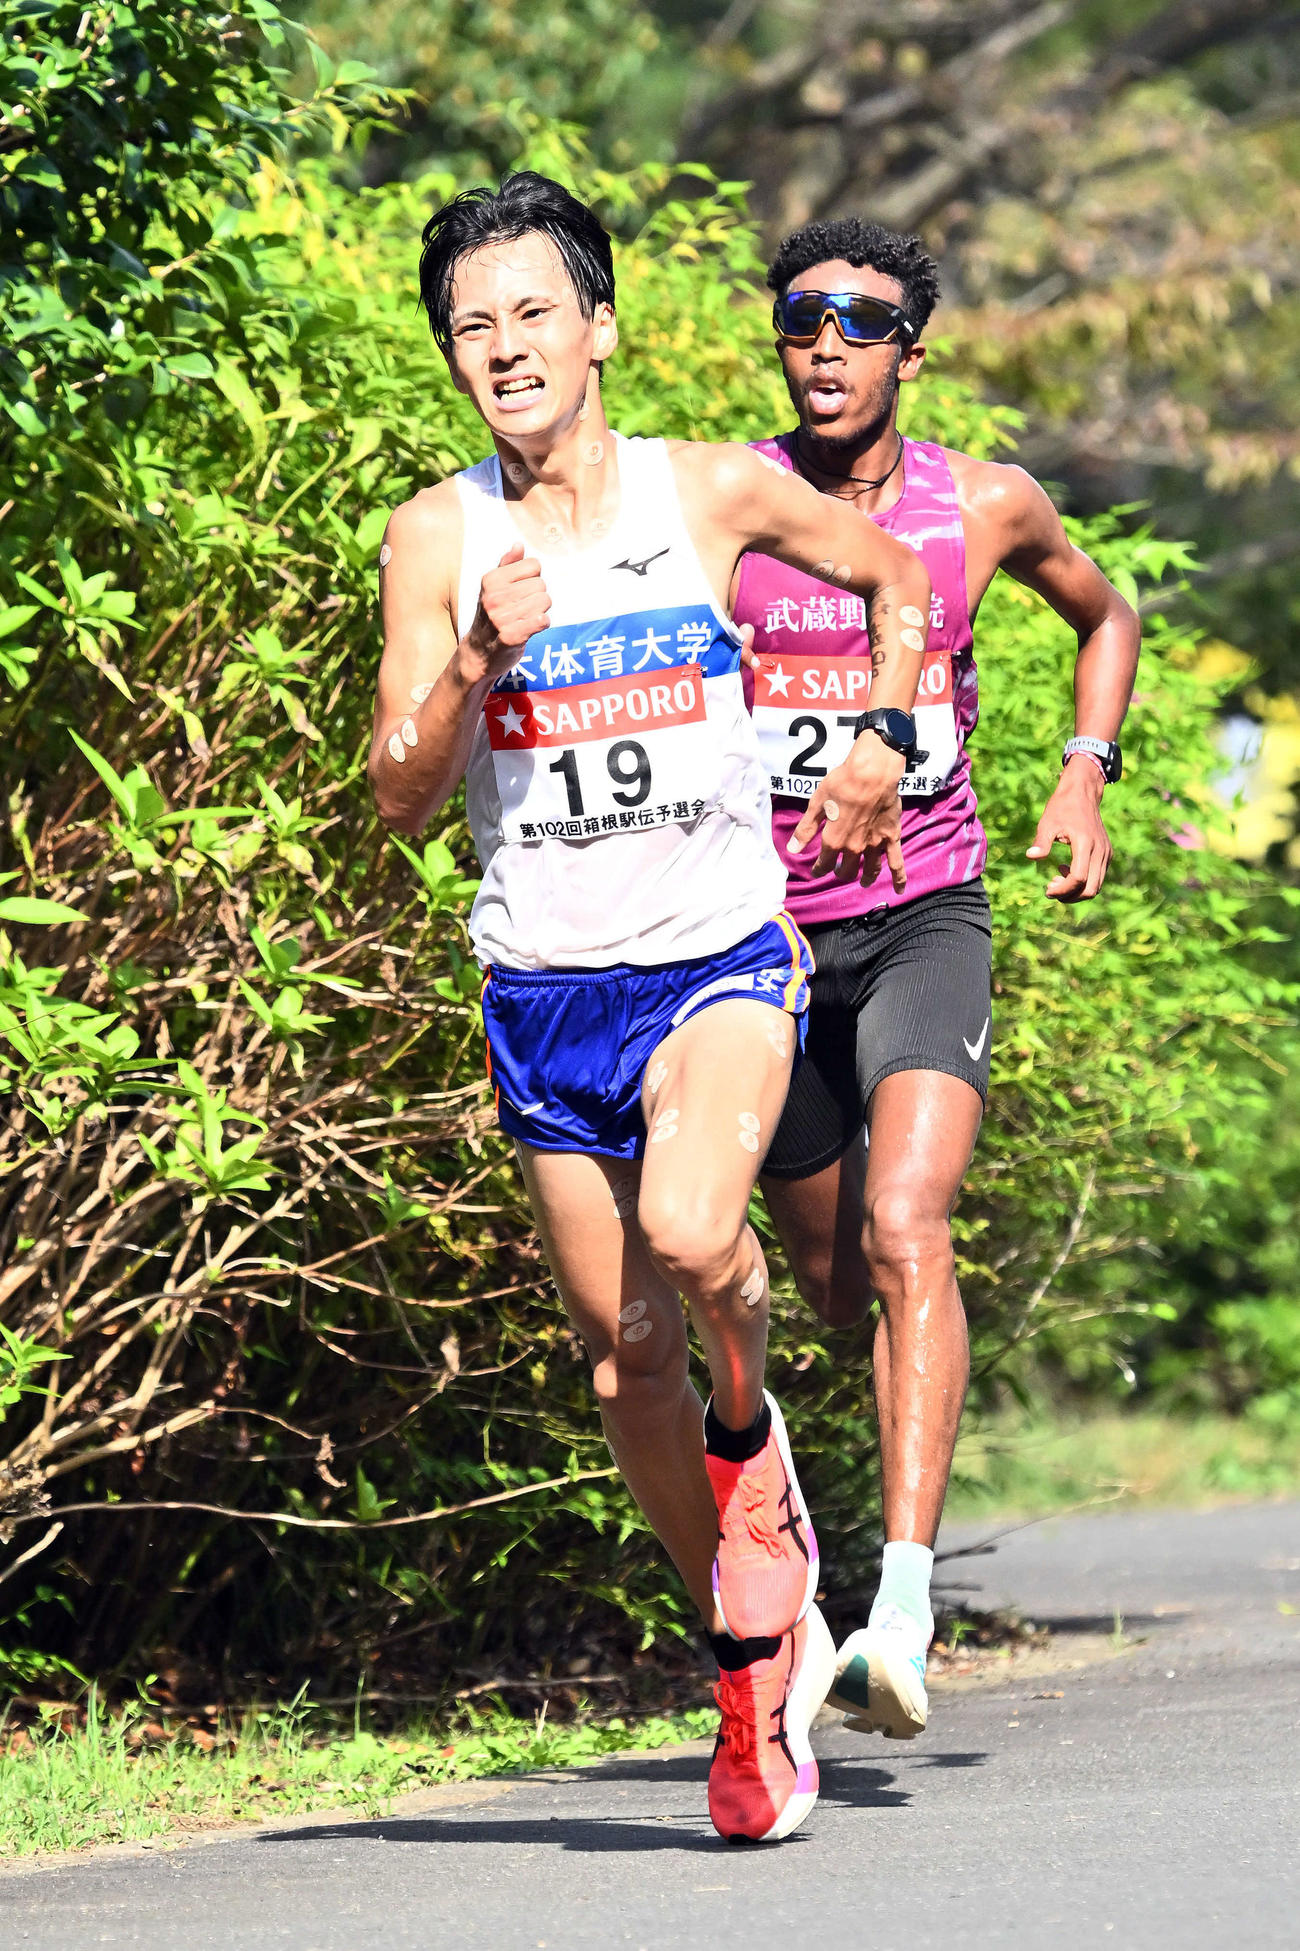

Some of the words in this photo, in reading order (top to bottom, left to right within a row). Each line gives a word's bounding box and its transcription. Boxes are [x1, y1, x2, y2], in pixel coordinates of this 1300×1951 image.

[764, 592, 944, 634] 武蔵野
[494, 621, 711, 690] 本体育大学
[802, 664, 946, 700] SAPO
[532, 680, 696, 736] SAPPORO
[549, 740, 652, 817] 19
[520, 798, 706, 839] 第102回箱根駅伝予選会
